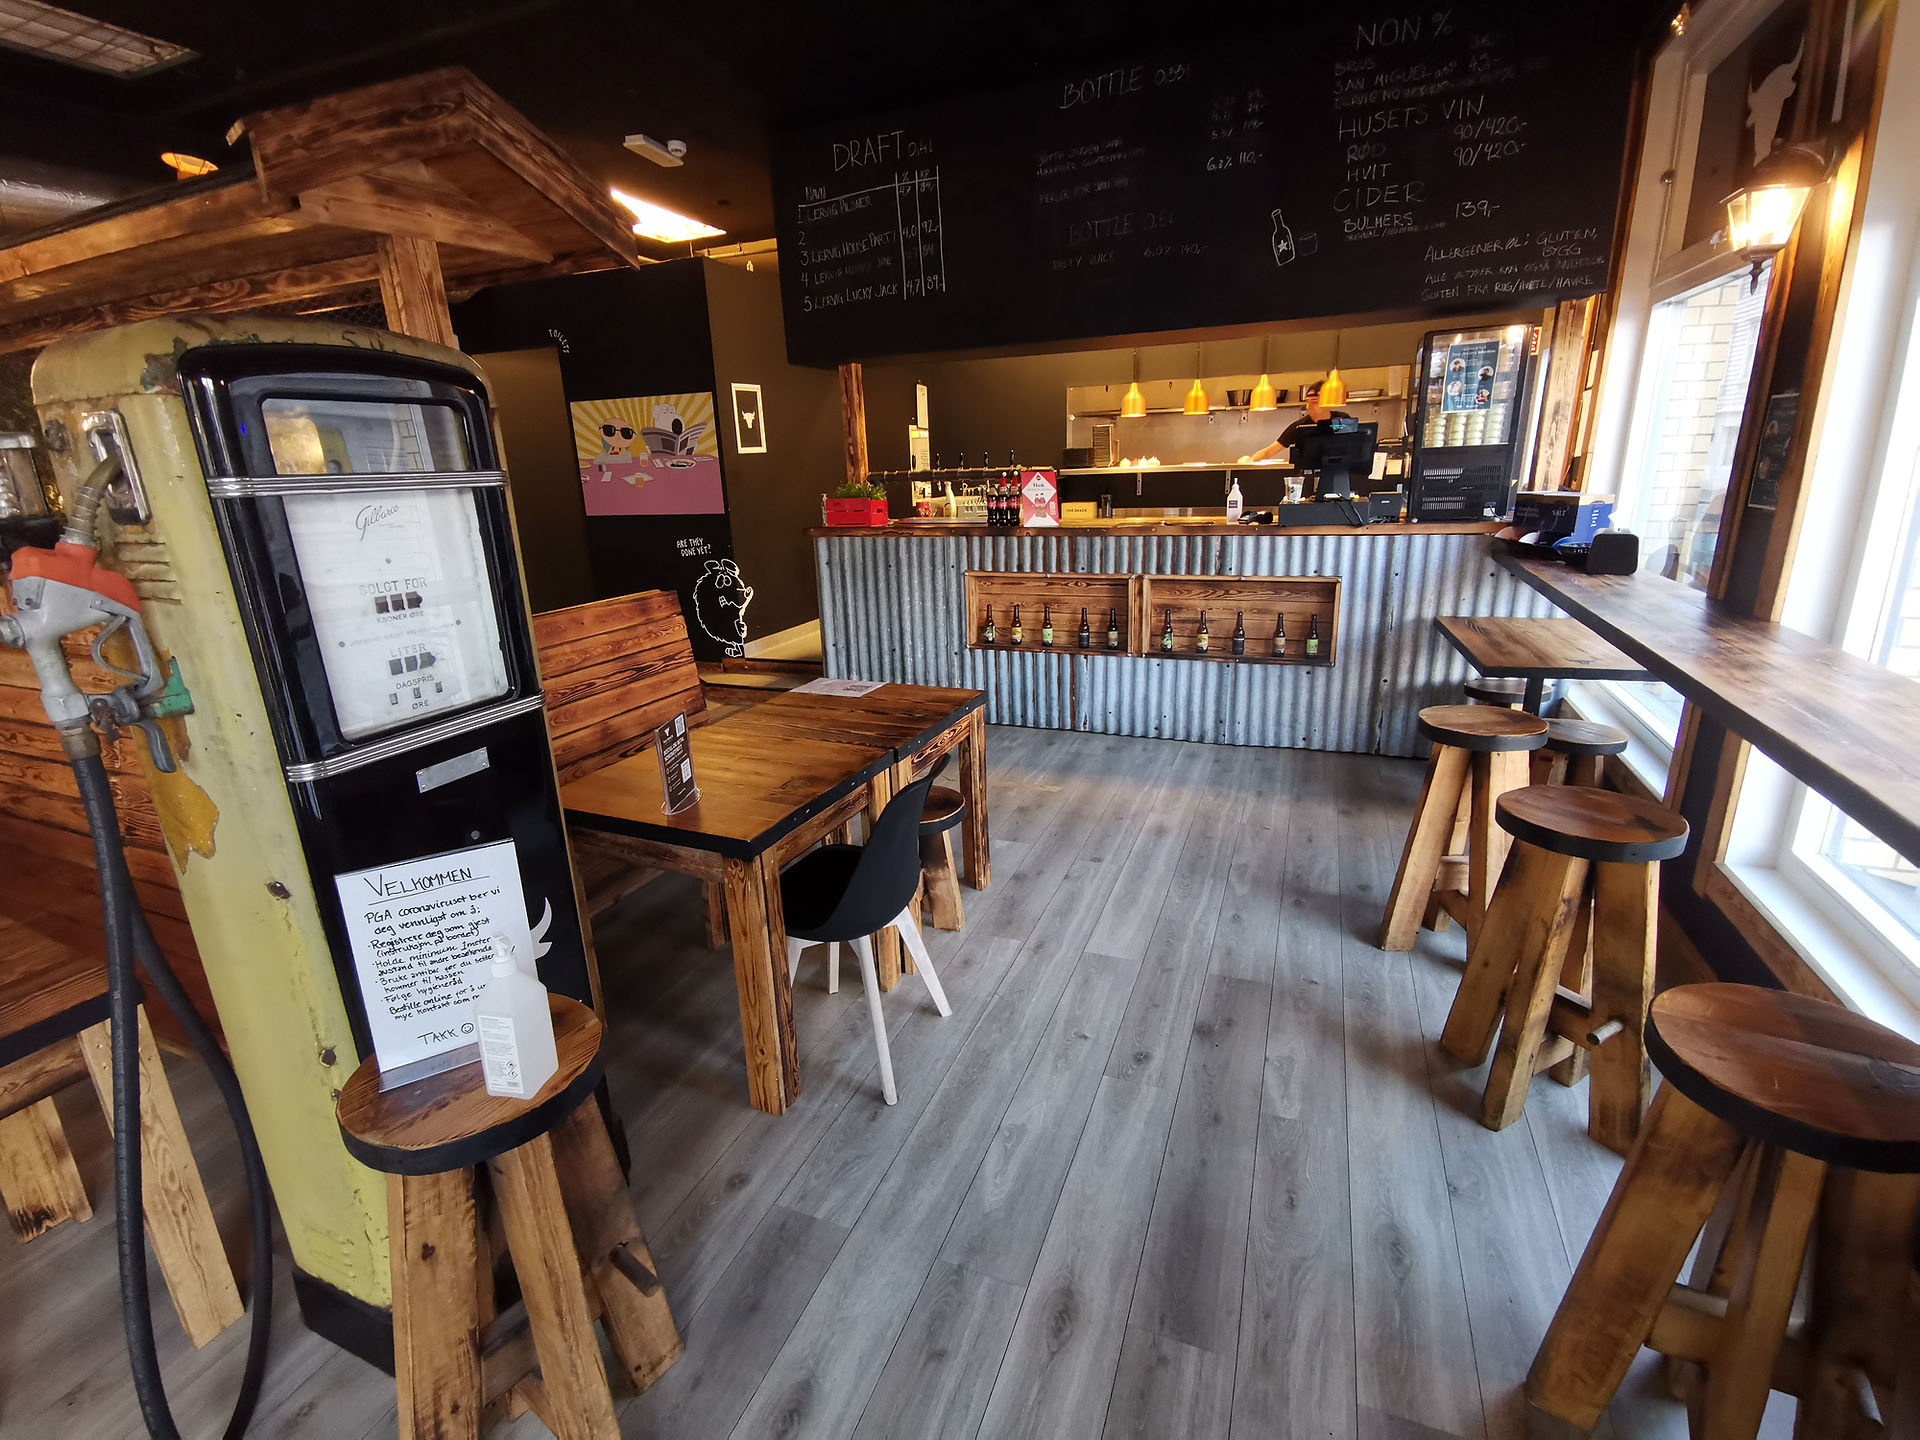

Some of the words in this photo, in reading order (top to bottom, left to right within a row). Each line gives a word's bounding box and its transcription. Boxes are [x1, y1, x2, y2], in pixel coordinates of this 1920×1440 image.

[1356, 16, 1421, 50] NON
[1431, 7, 1453, 38] %
[1058, 65, 1145, 109] BOTTLE
[1333, 78, 1365, 95] SAN
[1375, 64, 1433, 87] MIGUEL
[1337, 103, 1429, 143] HUSETS
[1442, 95, 1485, 120] VIN
[832, 129, 905, 172] DRAFT
[1346, 142, 1387, 165] RØD
[1347, 162, 1392, 183] HVIT
[1333, 180, 1426, 212] CIDER
[807, 203, 839, 222] LERVIG
[1343, 211, 1413, 233] BULMERS
[797, 230, 808, 246] 2
[1066, 212, 1135, 247] BOTTLE
[800, 250, 810, 266] 3
[869, 229, 897, 248] PARTY
[1424, 238, 1505, 263] ALLERGENER
[1542, 242, 1581, 258] BYGG
[800, 271, 809, 287] 4
[1424, 271, 1448, 285] ALLE
[803, 295, 813, 313] 5
[846, 284, 873, 303] LUCKY
[875, 282, 899, 299] JACK
[1421, 285, 1460, 301] GLUTEN
[1467, 283, 1489, 297] FRA
[548, 329, 570, 353] TOILETS
[355, 504, 399, 541] Gilbarco
[676, 539, 688, 549] ARE
[689, 537, 704, 547] THEY
[681, 547, 696, 557] DONE
[696, 544, 712, 555] YET?
[359, 580, 399, 595] SOLGT
[405, 576, 428, 590] FOR
[376, 613, 408, 625] KRONER
[390, 642, 427, 658] LITER
[395, 674, 435, 690] DAGSPRIS
[411, 699, 430, 710] ØRE
[363, 867, 473, 896] VELKOMMEN
[364, 909, 393, 924] PGA
[398, 895, 467, 917] coronaviruset
[469, 891, 488, 901] ber
[490, 885, 501, 895] vi
[370, 932, 423, 950] Registrere
[425, 929, 445, 941] deg
[444, 924, 464, 933] som
[468, 917, 491, 932] gjest
[374, 925, 397, 936] deg
[398, 911, 448, 931] vennligst
[450, 910, 467, 919] om
[374, 957, 405, 969] Holde
[378, 963, 414, 977] avstand
[419, 958, 428, 968] til
[429, 955, 449, 966] andre
[379, 974, 408, 987] Bruke
[460, 959, 472, 968] du
[384, 980, 418, 994] kommer
[422, 975, 432, 985] til
[435, 969, 464, 981] kassen
[389, 1000, 422, 1015] Bestille
[423, 993, 453, 1006] online
[395, 1012, 413, 1022] mye
[416, 1001, 450, 1014] kontakt
[453, 997, 470, 1006] som
[416, 1028, 459, 1045] TAKK
